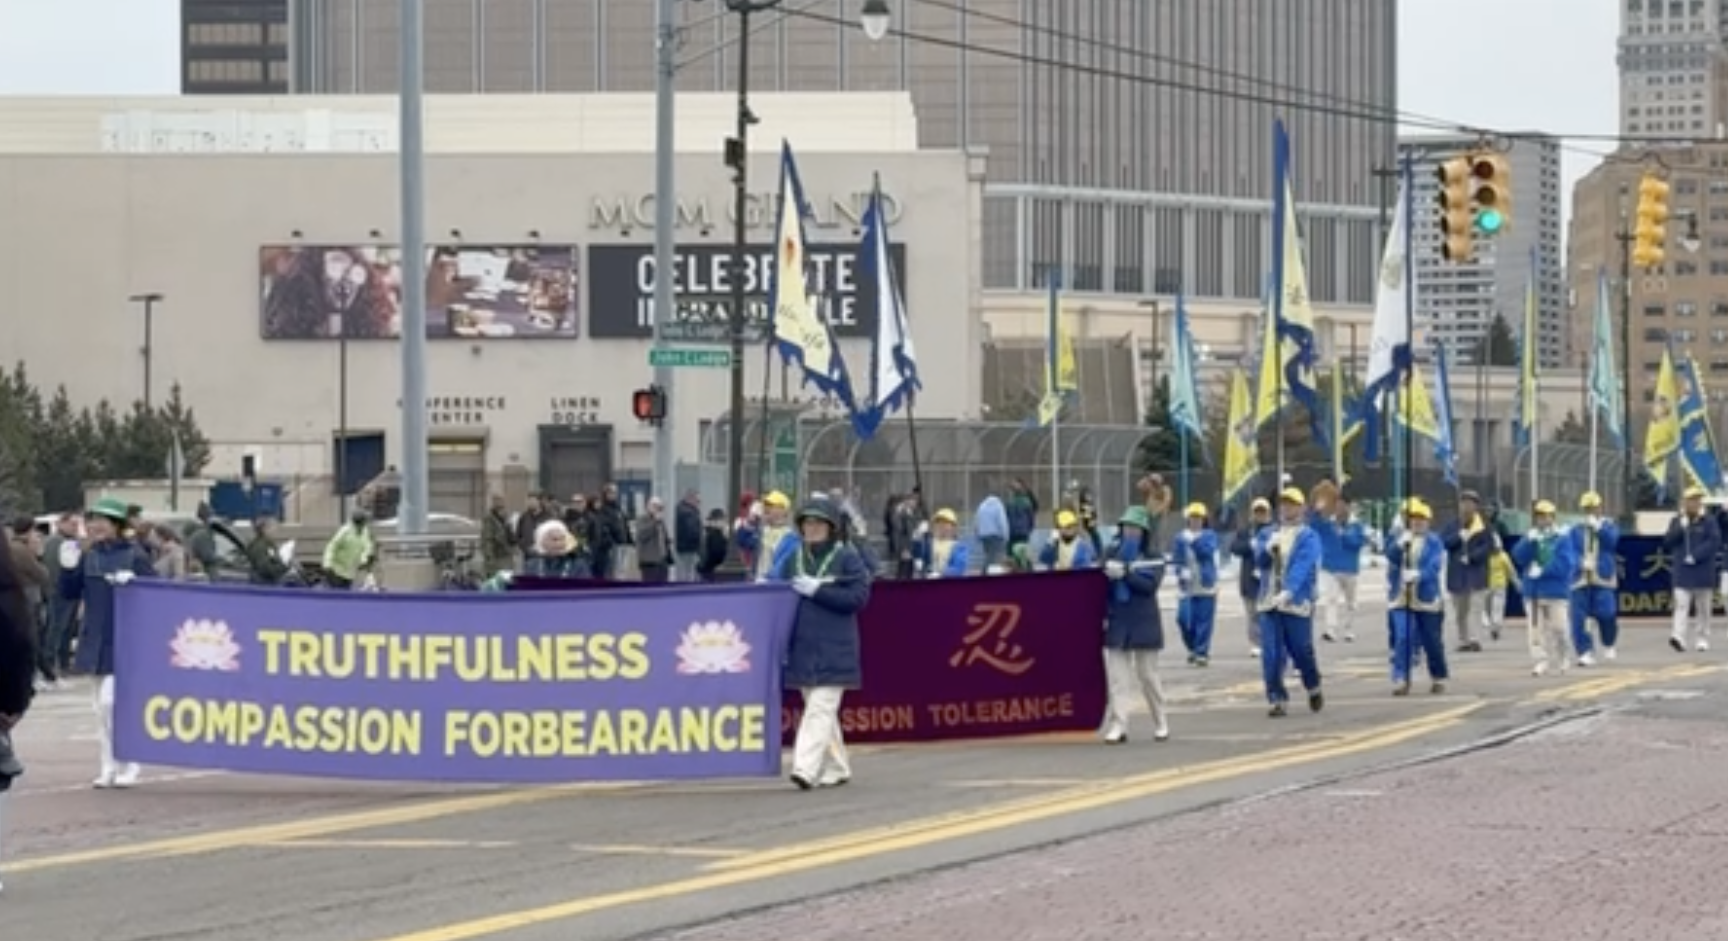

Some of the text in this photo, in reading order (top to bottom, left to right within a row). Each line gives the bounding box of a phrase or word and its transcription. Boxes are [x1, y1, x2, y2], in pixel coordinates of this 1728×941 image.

[637, 254, 857, 293] CELEBRTE
[425, 411, 482, 424] ENTER
[551, 396, 600, 410] LINEN
[552, 411, 599, 425] DOCK
[257, 629, 650, 681] TRUTHFULNESS
[144, 695, 765, 757] COMPASSION FORBEARANCE
[927, 692, 1075, 727] TOLERANCE
